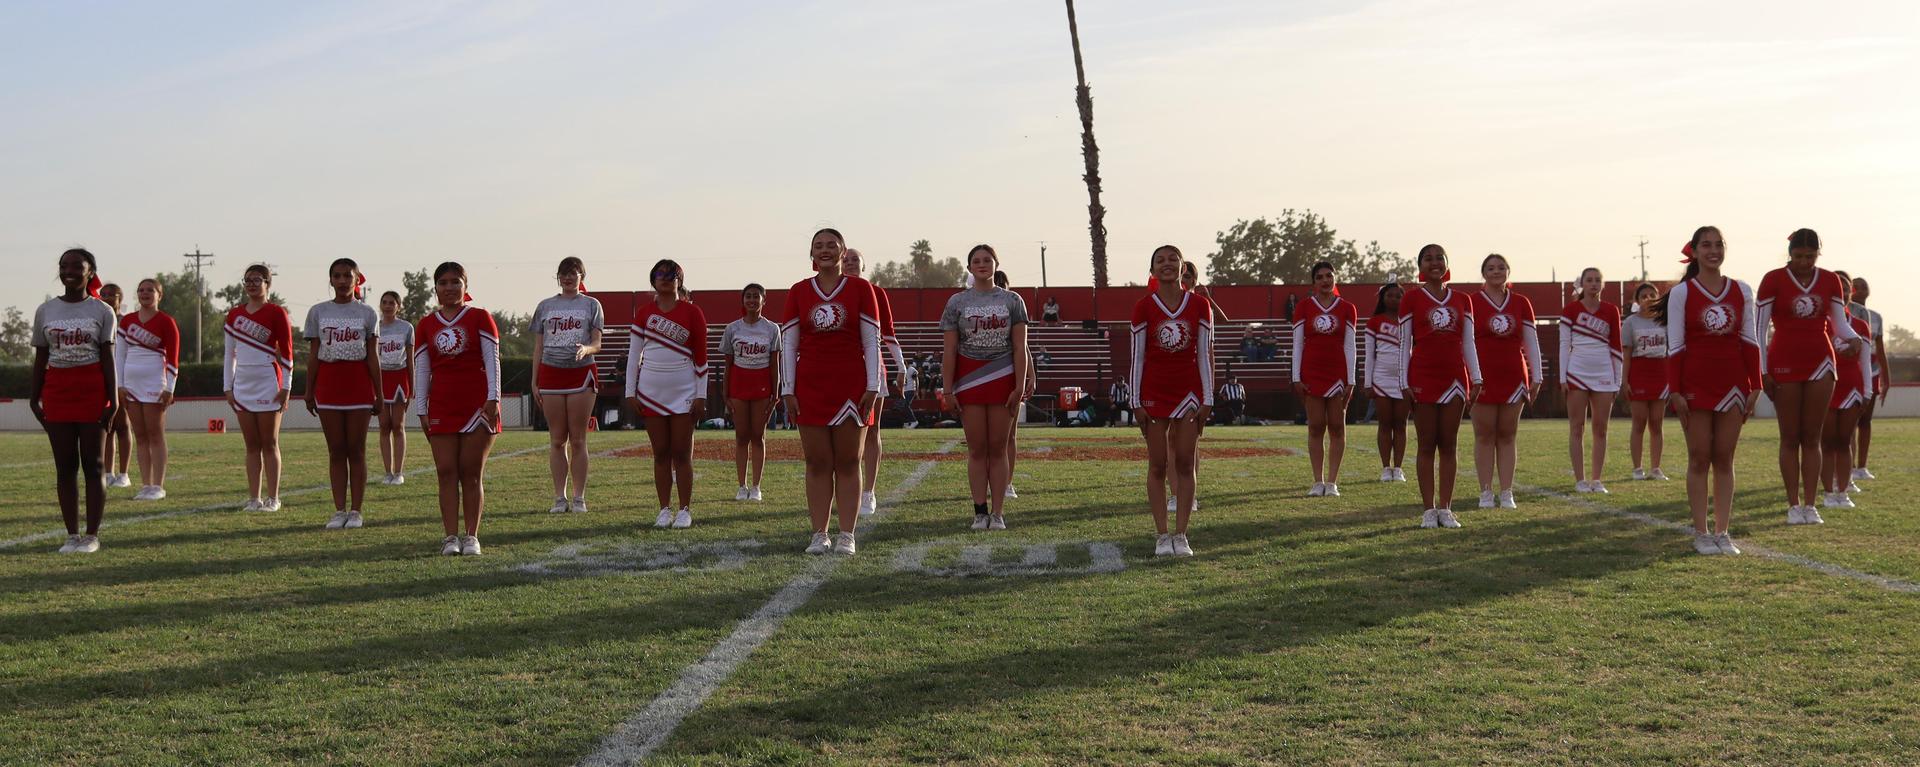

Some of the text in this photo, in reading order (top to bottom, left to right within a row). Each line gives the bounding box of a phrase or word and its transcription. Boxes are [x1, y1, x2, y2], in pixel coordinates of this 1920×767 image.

[549, 316, 582, 335] Tribe
[968, 314, 1009, 333] Tribe
[48, 327, 92, 350] Tribe
[322, 327, 361, 346] Tribe
[1639, 334, 1664, 351] Tribe
[379, 341, 401, 355] Tribe
[736, 341, 767, 358] Tribe
[209, 418, 224, 431] 30
